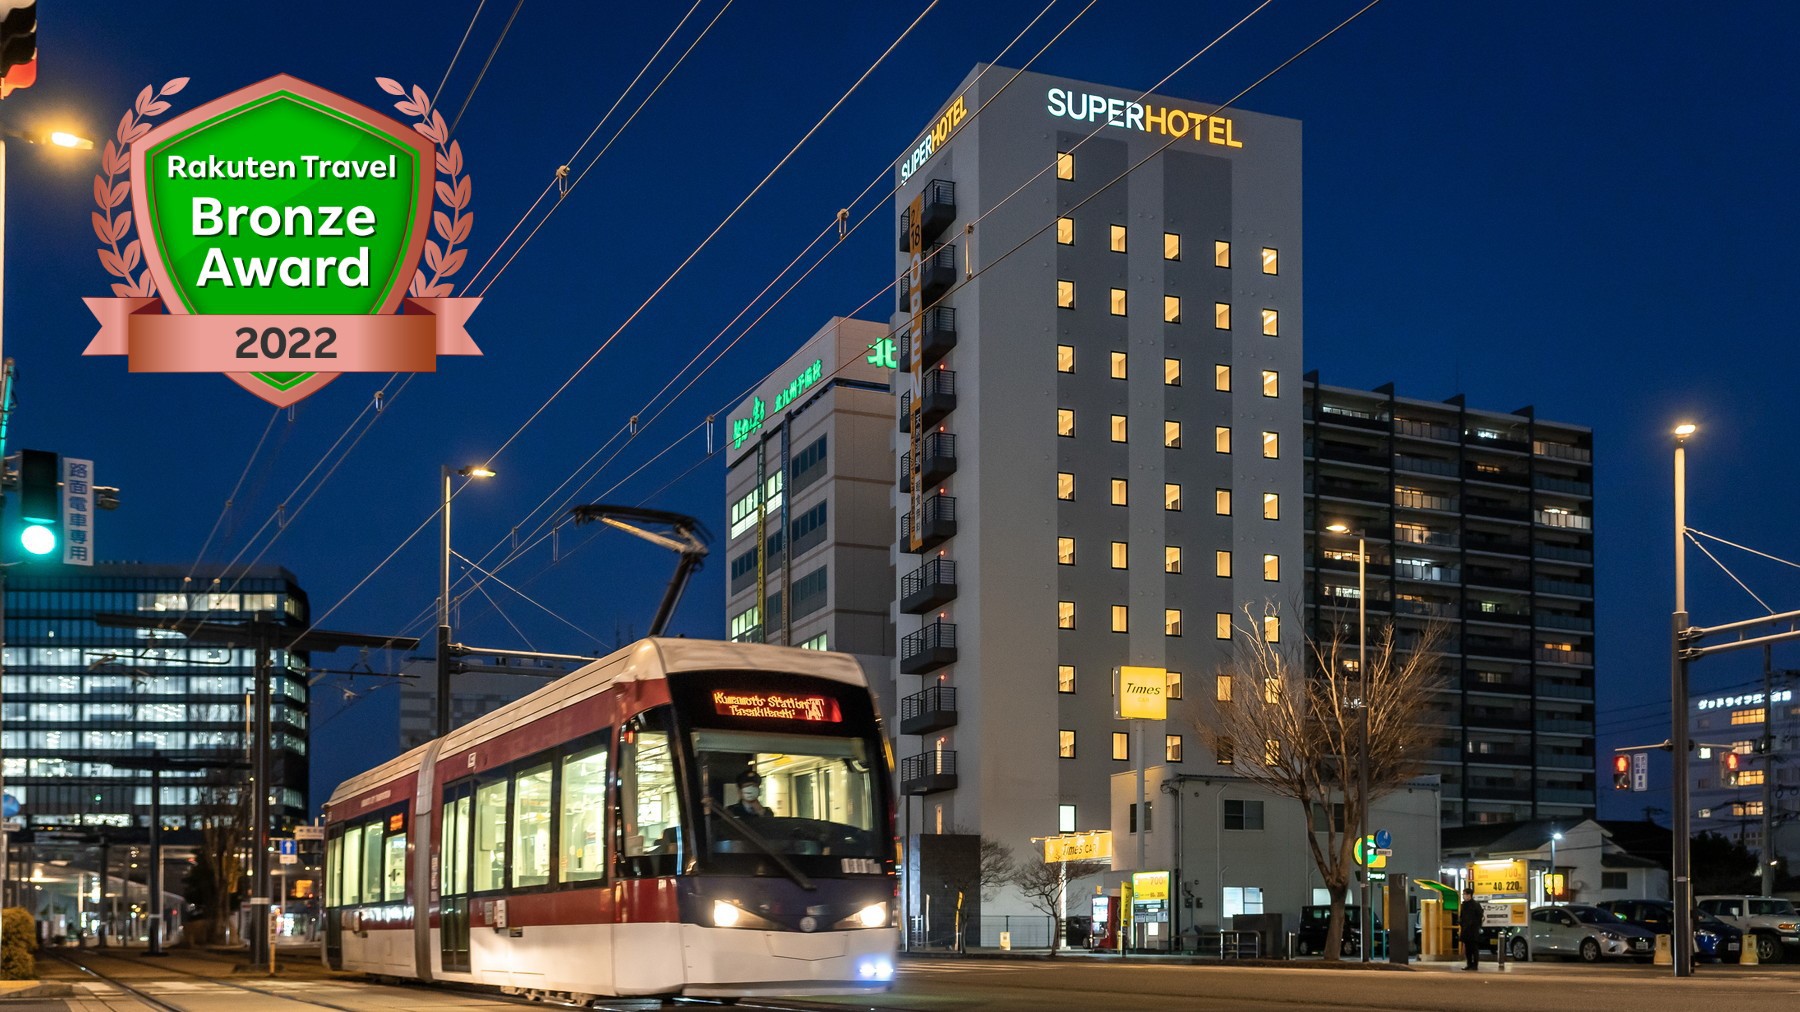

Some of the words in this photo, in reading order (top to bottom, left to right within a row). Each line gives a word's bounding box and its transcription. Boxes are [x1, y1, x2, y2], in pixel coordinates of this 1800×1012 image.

[1047, 87, 1243, 148] SUPERHOTEL
[910, 252, 921, 403] OPEN
[69, 462, 87, 561] 路面電車専用
[1126, 682, 1161, 695] Times
